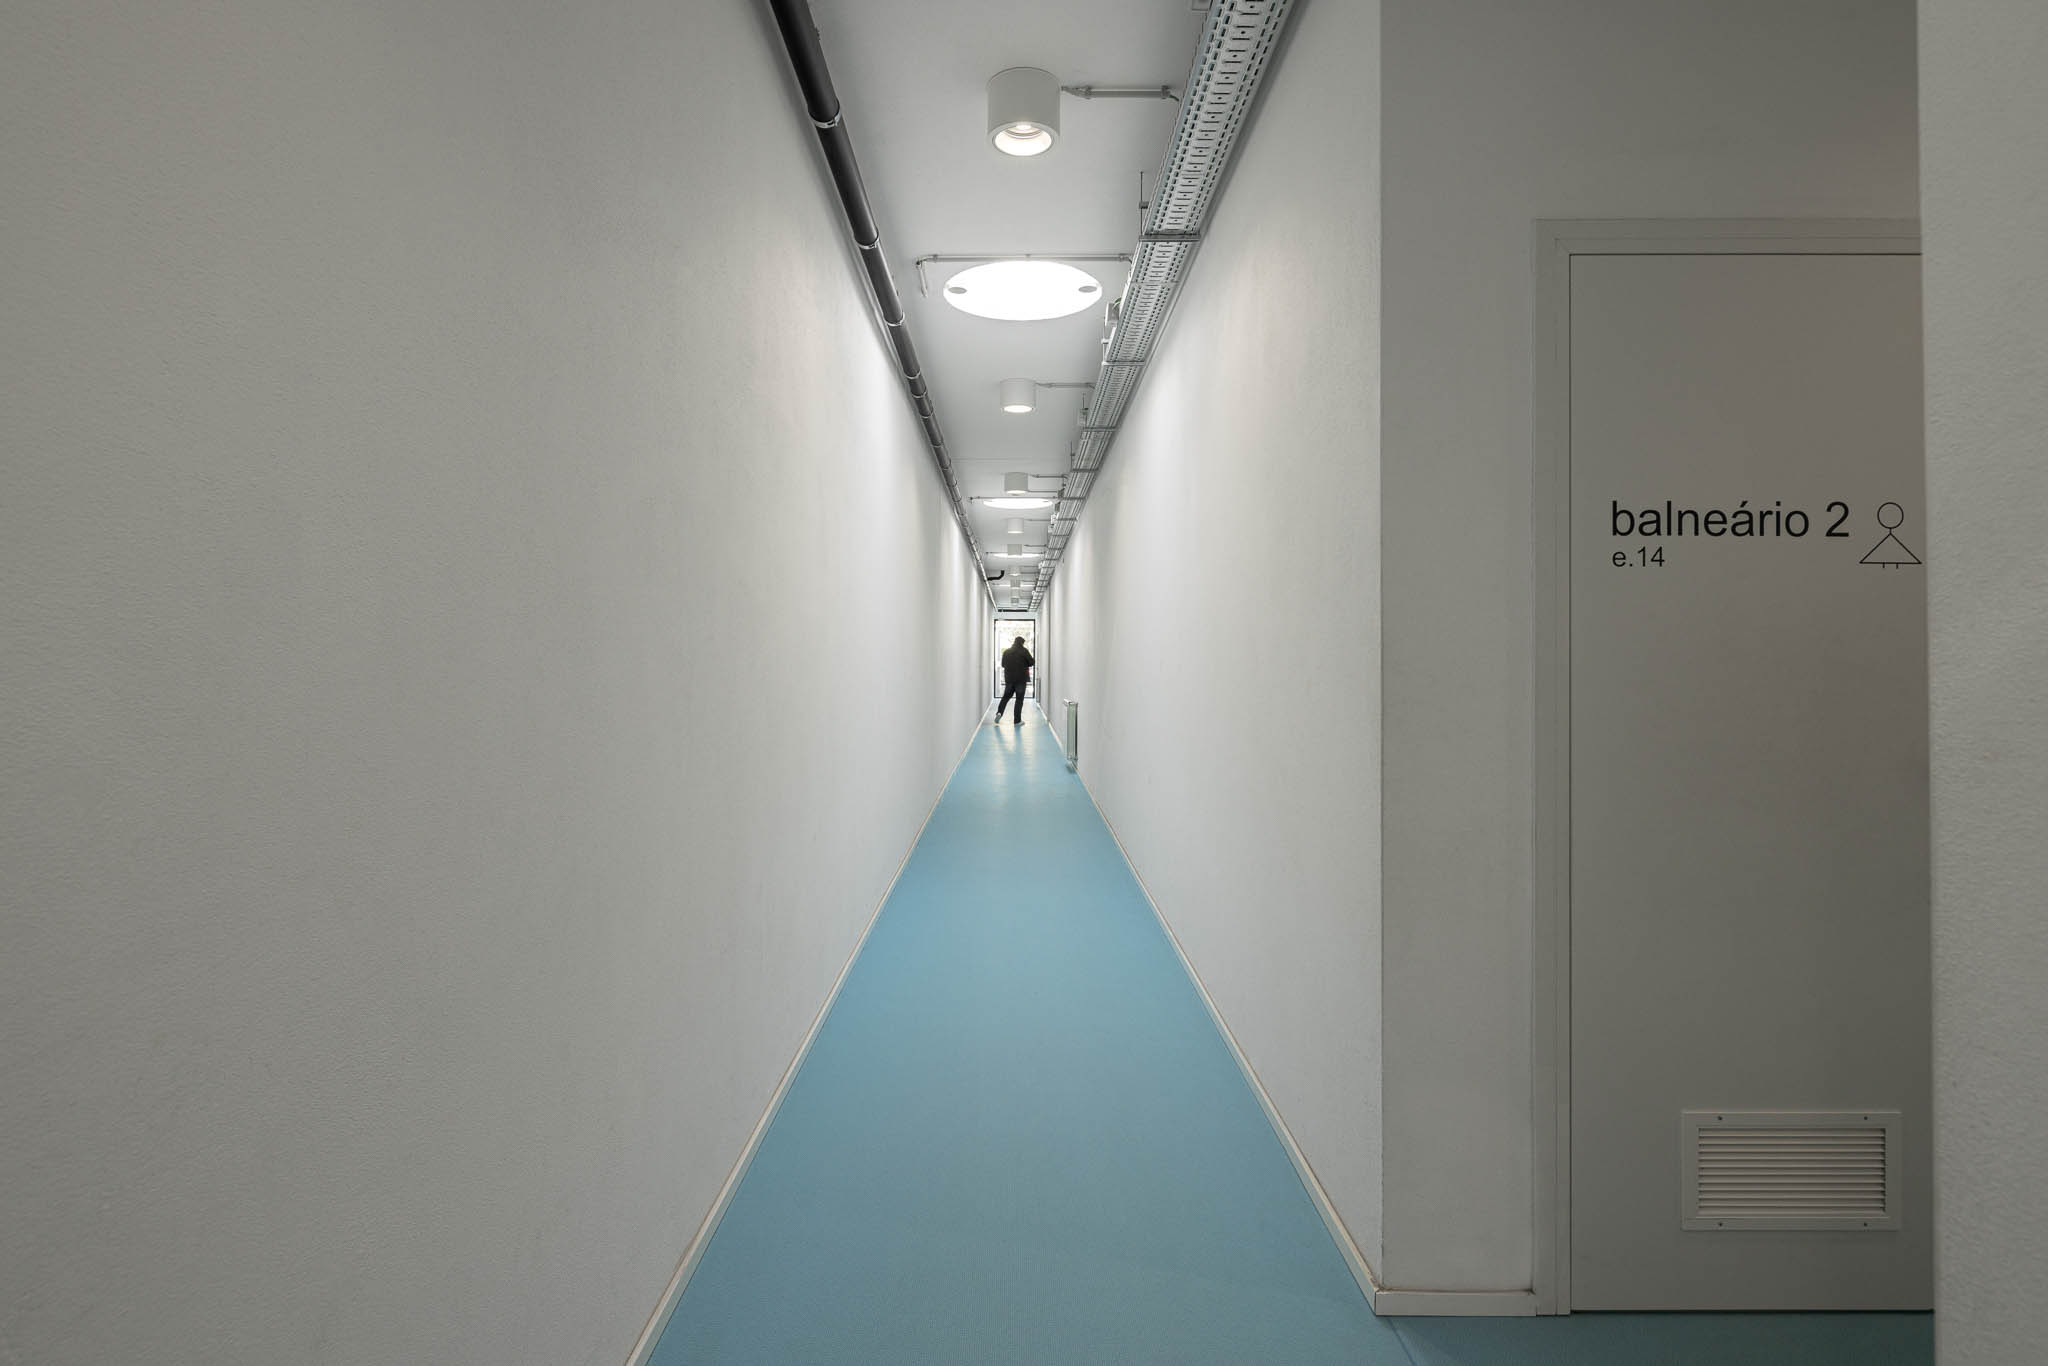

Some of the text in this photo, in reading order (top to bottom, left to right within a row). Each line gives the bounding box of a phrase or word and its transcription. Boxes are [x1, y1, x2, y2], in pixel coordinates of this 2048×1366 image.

[1612, 500, 1850, 538] balneário 2
[1612, 545, 1666, 568] e.14
